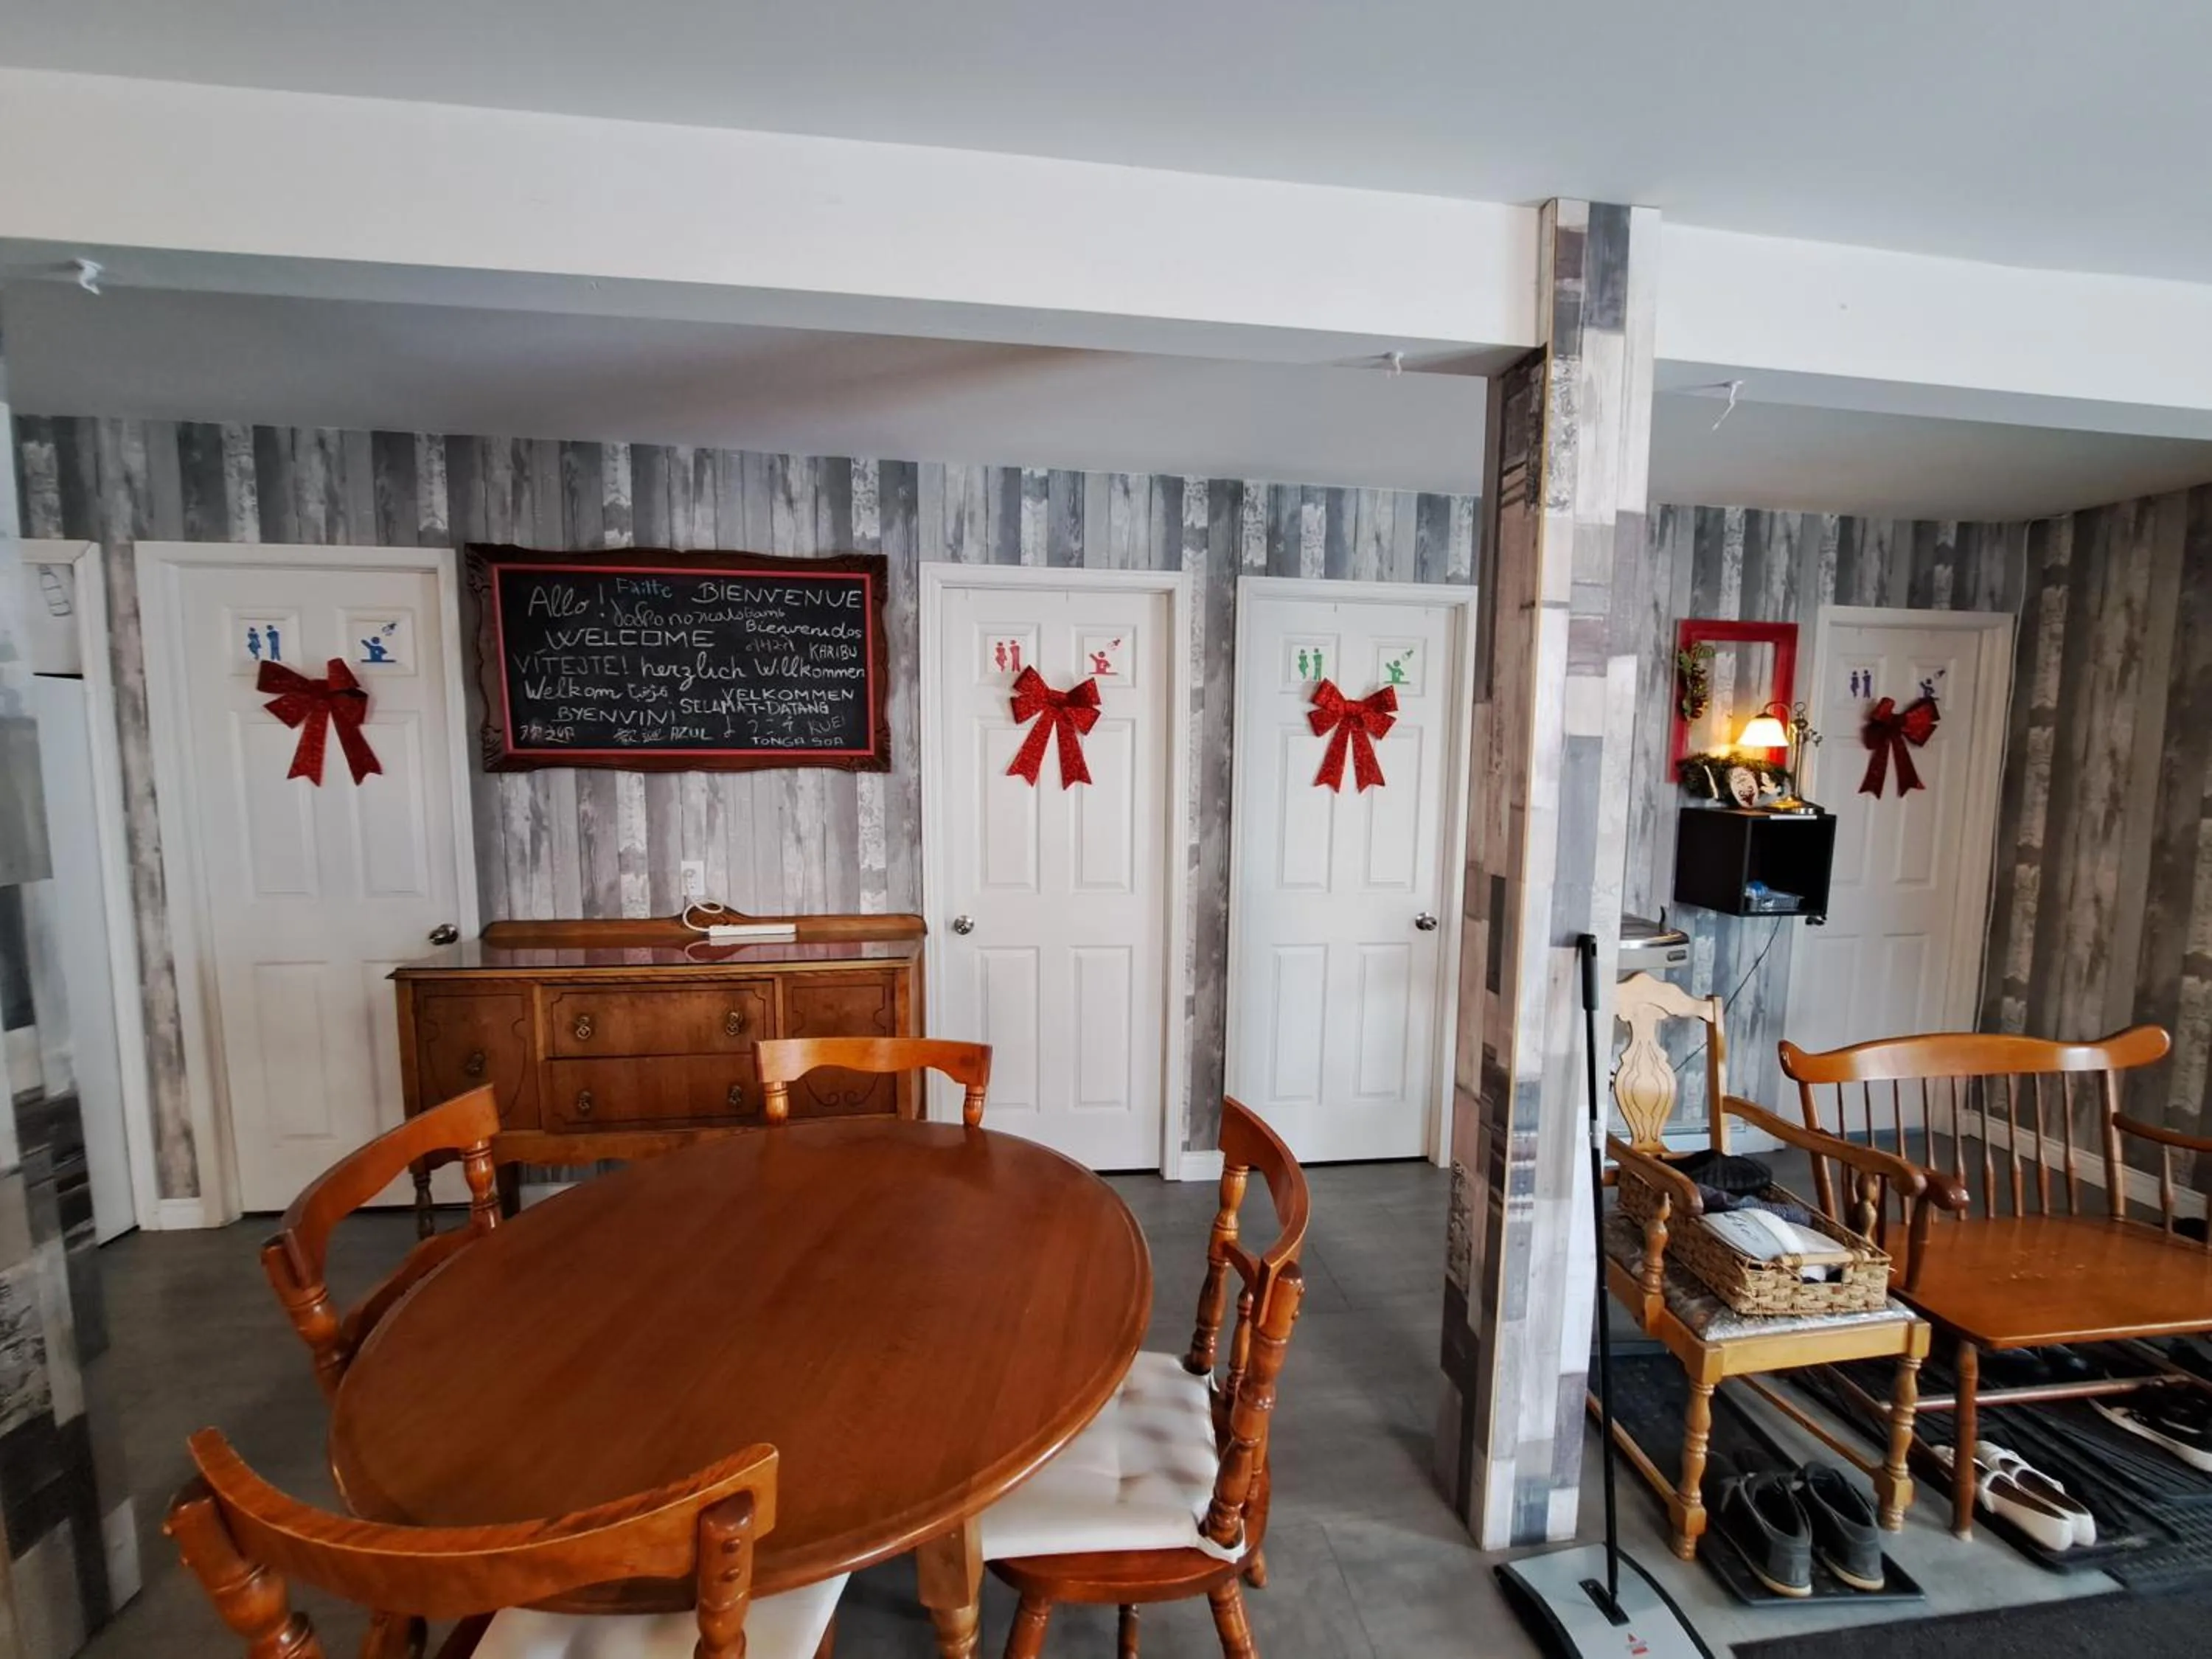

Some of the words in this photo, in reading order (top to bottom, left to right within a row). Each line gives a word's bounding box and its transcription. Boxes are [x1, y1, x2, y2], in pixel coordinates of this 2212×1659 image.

[527, 585, 589, 618] Allo
[545, 628, 715, 650] WELCOME
[745, 619, 862, 639] Bienvenidos
[809, 643, 858, 661] KARIBU
[641, 651, 747, 691] herzlich
[754, 655, 866, 678] Willkommen
[524, 675, 624, 700] Welkom
[721, 688, 854, 702] VELKOMMEN
[670, 726, 714, 740] AZUL
